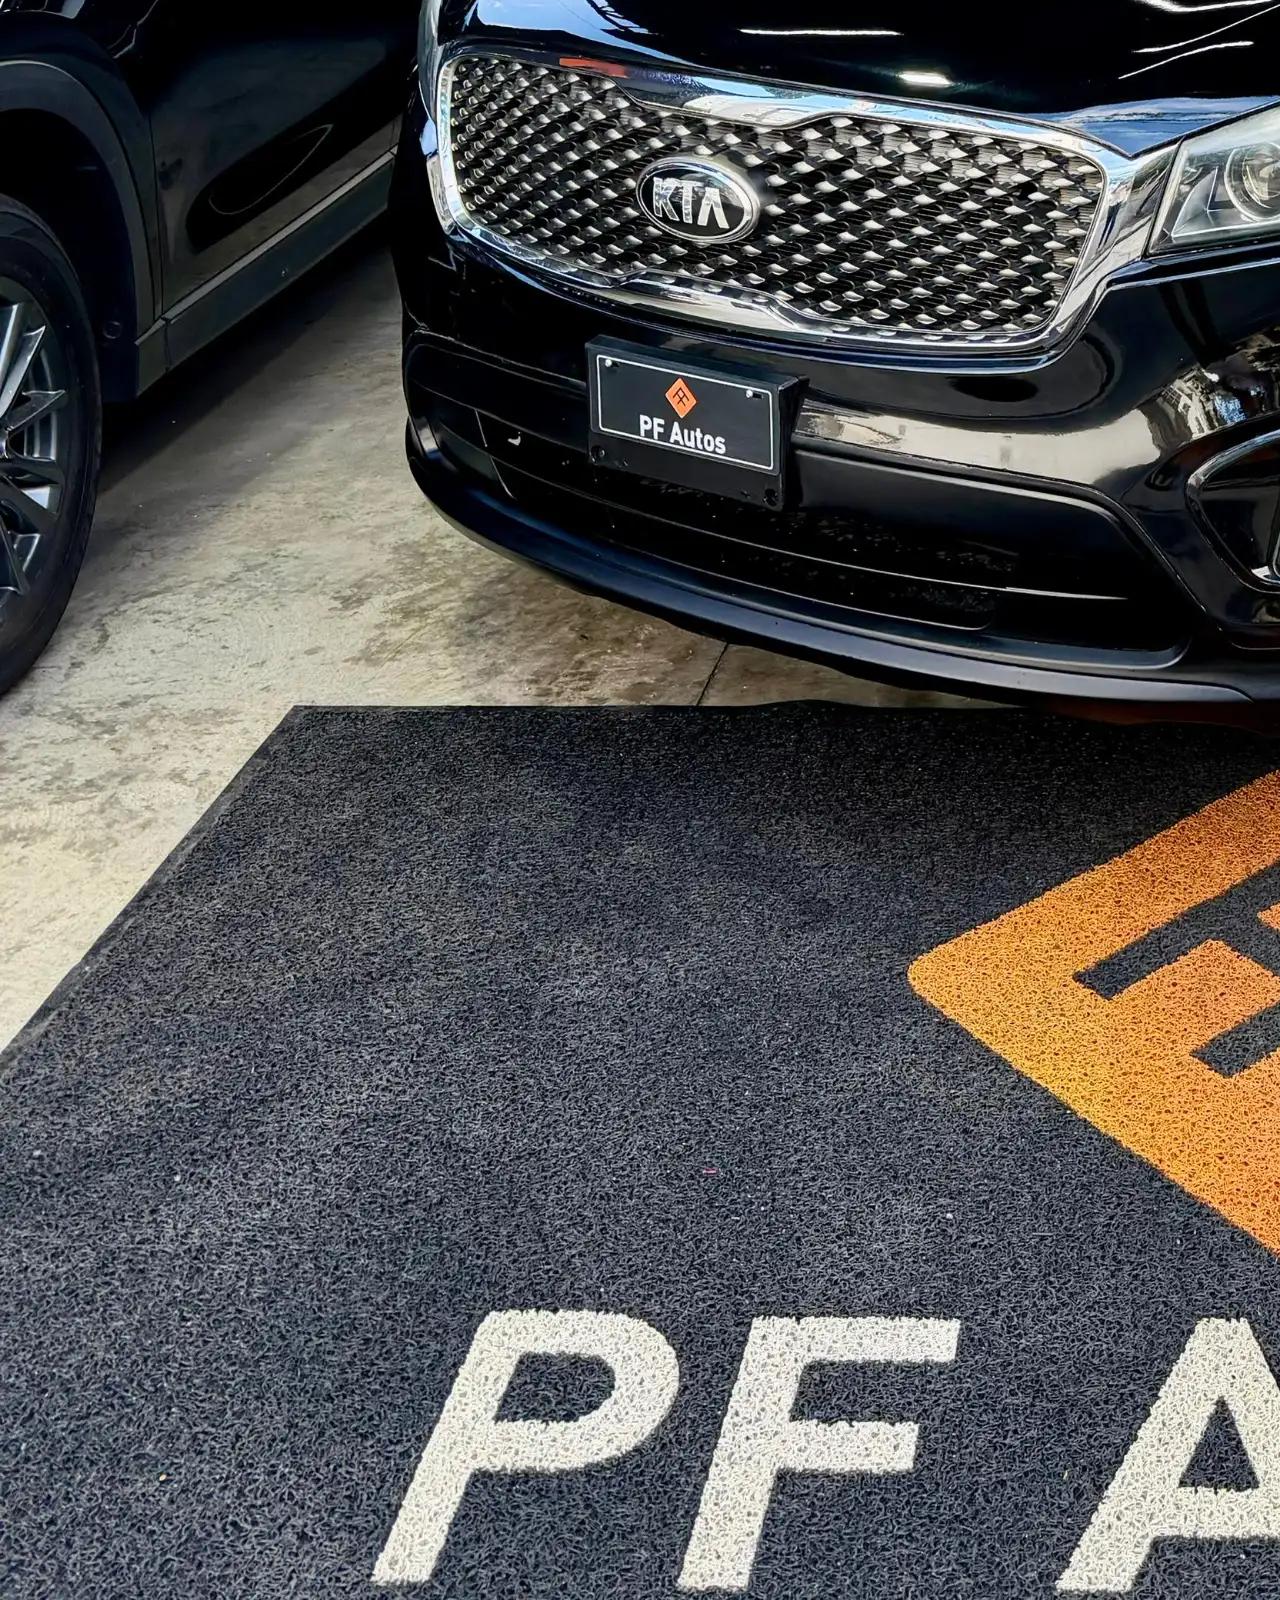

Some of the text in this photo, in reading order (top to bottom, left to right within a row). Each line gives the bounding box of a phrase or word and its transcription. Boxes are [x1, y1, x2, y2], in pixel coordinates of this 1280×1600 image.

[639, 414, 726, 454] PF Autos
[370, 1308, 962, 1592] PF
